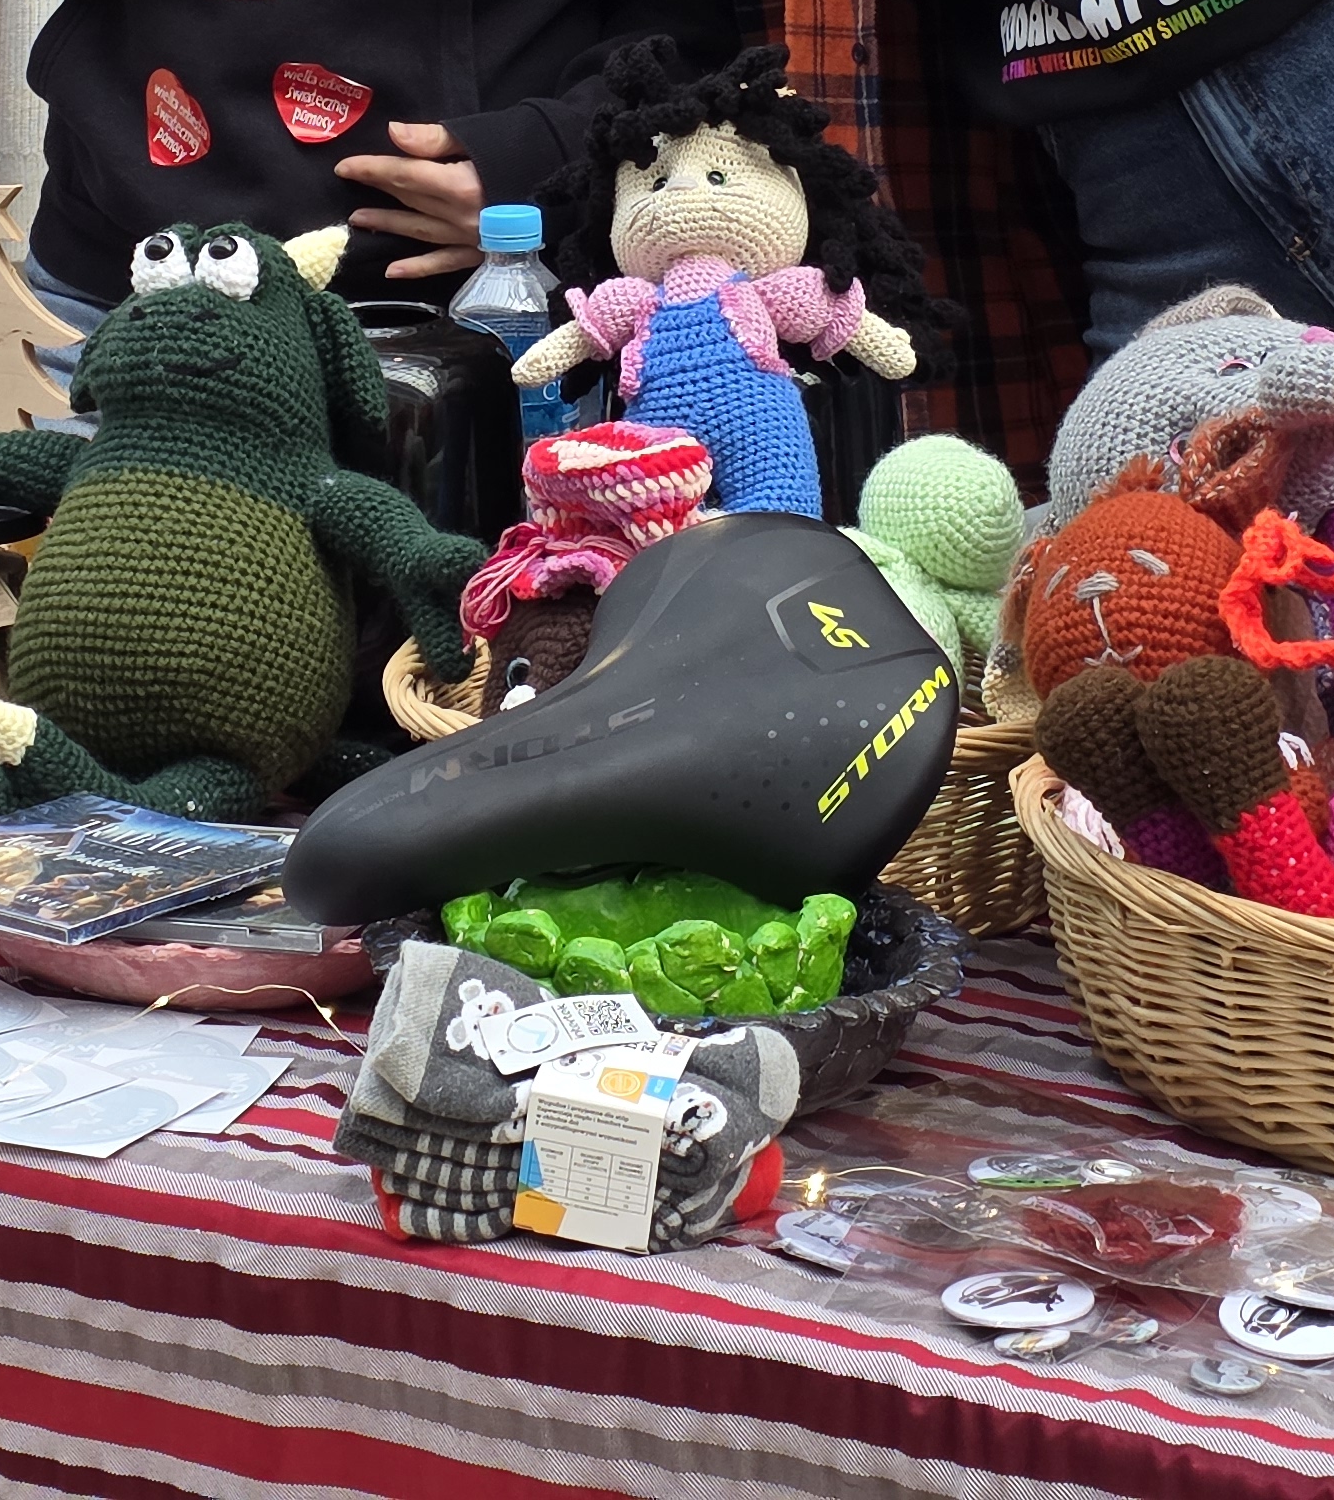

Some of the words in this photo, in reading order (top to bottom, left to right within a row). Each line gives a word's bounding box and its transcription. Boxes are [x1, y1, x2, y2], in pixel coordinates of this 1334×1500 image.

[1037, 46, 1102, 75] WIELKIEJ
[153, 84, 180, 111] wielka
[283, 68, 318, 86] wielka
[318, 75, 364, 100] orkiestra
[292, 105, 337, 134] pomocy
[152, 126, 188, 163] pomocy
[817, 665, 951, 823] STORM
